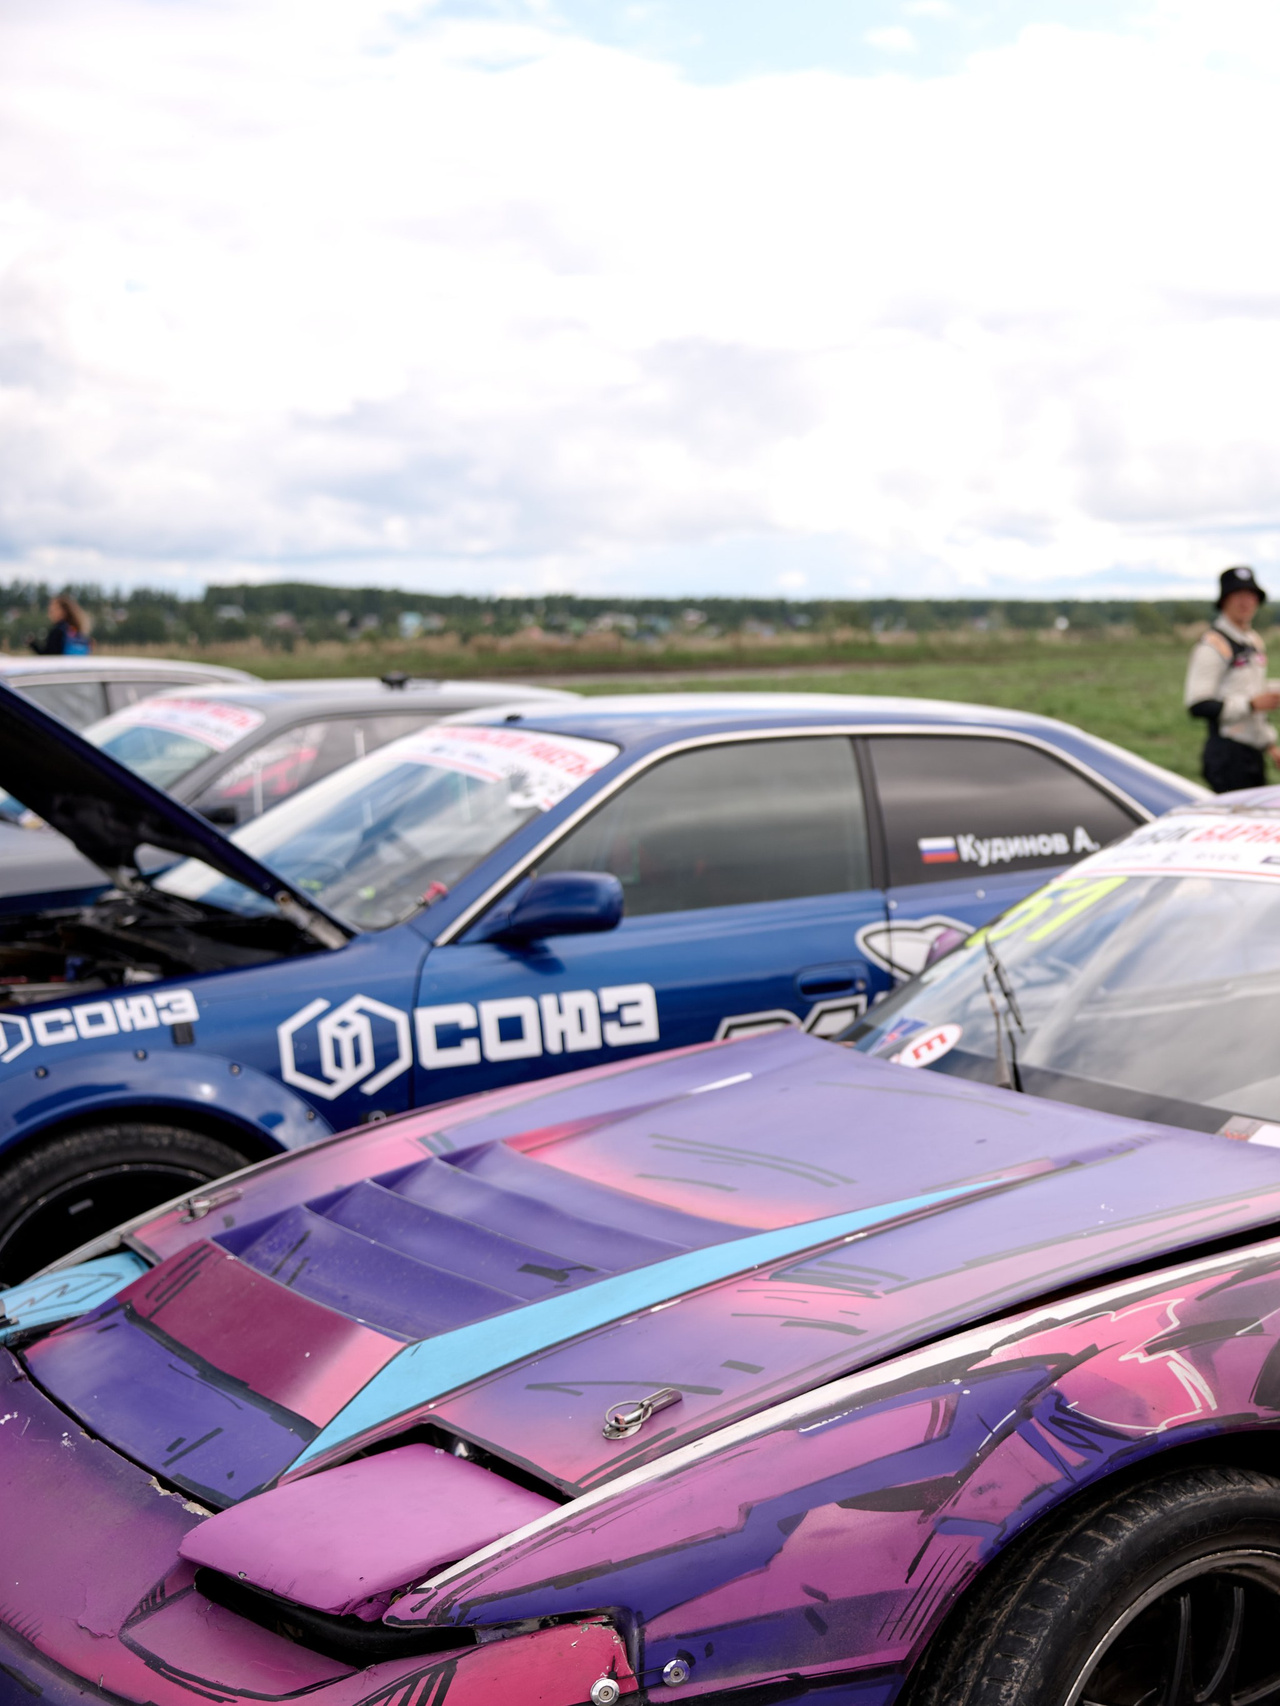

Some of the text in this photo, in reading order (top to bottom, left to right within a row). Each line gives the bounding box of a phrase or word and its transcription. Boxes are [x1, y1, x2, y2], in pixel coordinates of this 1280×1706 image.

[956, 833, 1070, 867] Кудинов
[1074, 826, 1101, 852] А.
[30, 988, 200, 1047] СОЮЗ
[413, 983, 660, 1070] СОЮЗ
